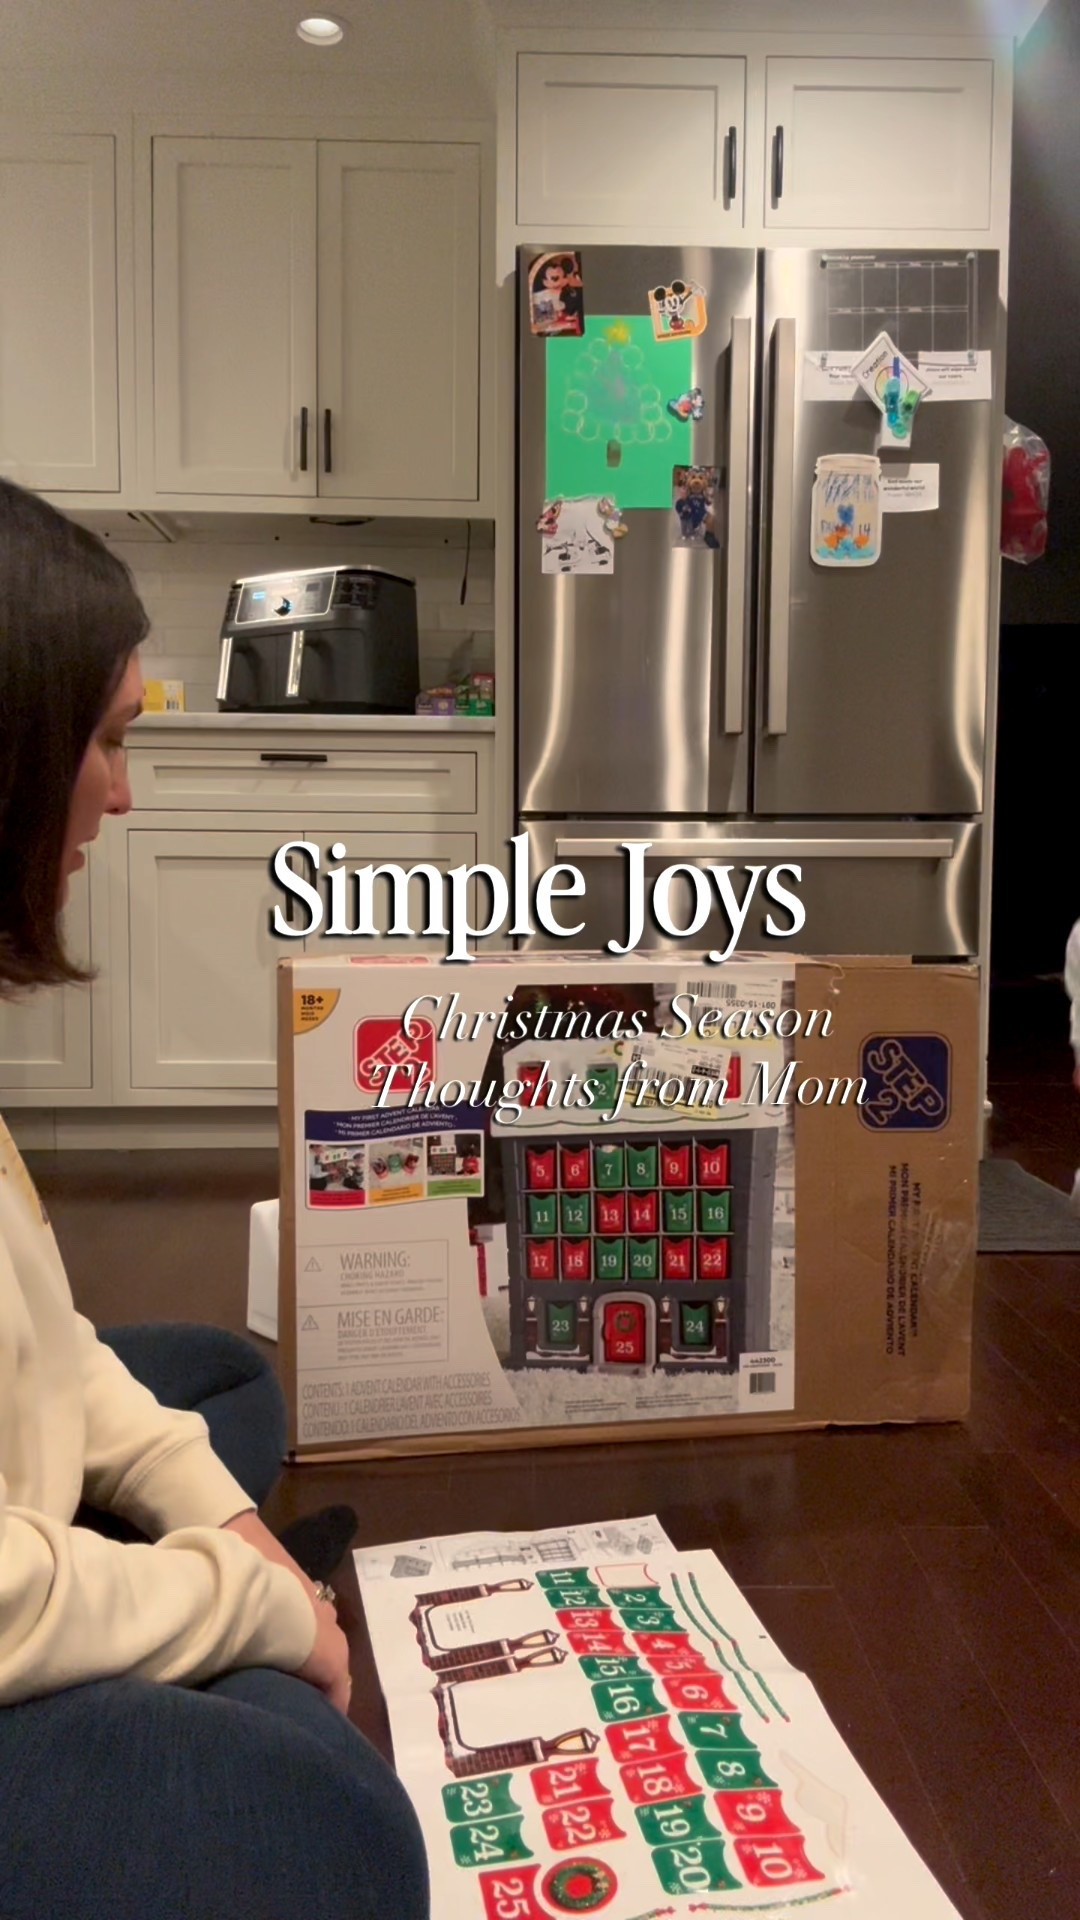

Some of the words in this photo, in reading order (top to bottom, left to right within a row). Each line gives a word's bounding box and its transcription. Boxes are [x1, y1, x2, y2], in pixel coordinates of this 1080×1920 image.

[862, 350, 888, 379] Creation
[301, 994, 324, 1005] 18+
[867, 1039, 943, 1116] STEP
[598, 1085, 607, 1095] 2
[865, 1087, 901, 1126] 2
[380, 1109, 405, 1119] ADVENT
[381, 1114, 419, 1126] CALENDRIER
[371, 1123, 411, 1136] CALENDARIO
[537, 1165, 545, 1177] 5
[571, 1164, 579, 1175] 6
[605, 1164, 613, 1175] 7
[637, 1163, 645, 1175] 8
[670, 1162, 678, 1174] 9
[703, 1161, 720, 1174] 10
[536, 1211, 548, 1222] 11
[568, 1210, 583, 1222] 12
[603, 1209, 618, 1221] 13
[634, 1209, 650, 1220] 14
[671, 1209, 687, 1220] 15
[707, 1207, 724, 1220] 16
[340, 1250, 411, 1270] WARNING:
[533, 1256, 548, 1267] 17
[568, 1255, 583, 1267] 18
[601, 1255, 617, 1266] 19
[633, 1254, 652, 1266] 20
[669, 1254, 684, 1266] 21
[703, 1254, 722, 1266] 22
[338, 1310, 370, 1328] MISE
[374, 1309, 391, 1326] EN
[395, 1306, 444, 1325] GARDE:
[552, 1320, 570, 1332] 23
[686, 1321, 704, 1332] 24
[616, 1342, 634, 1353] 25
[350, 1379, 382, 1396] ADVENT
[383, 1376, 422, 1394] CALENDAR
[423, 1375, 443, 1390] WITH
[444, 1372, 491, 1389] ACCESSORIES
[444, 1390, 492, 1407] ACCESSOIRES
[551, 1571, 575, 1584] 11
[560, 1590, 586, 1606] 12
[625, 1593, 646, 1603] 2
[571, 1611, 598, 1628] 13
[637, 1615, 660, 1626] 3
[583, 1633, 613, 1653] 14
[651, 1638, 676, 1650] 4
[595, 1657, 627, 1676] 15
[666, 1660, 691, 1670] 5
[608, 1683, 640, 1714] 16
[681, 1684, 708, 1700] 6
[700, 1723, 728, 1739] 7
[622, 1726, 658, 1753] 17
[717, 1760, 746, 1777] 8
[548, 1767, 583, 1799] 21
[637, 1763, 672, 1796] 18
[460, 1782, 493, 1818] 23
[736, 1803, 767, 1823] 9
[560, 1806, 597, 1845] 22
[654, 1804, 691, 1837] 19
[469, 1825, 505, 1862] 24
[753, 1843, 793, 1880] 10
[670, 1846, 711, 1892] 20
[492, 1878, 531, 1919] 25
